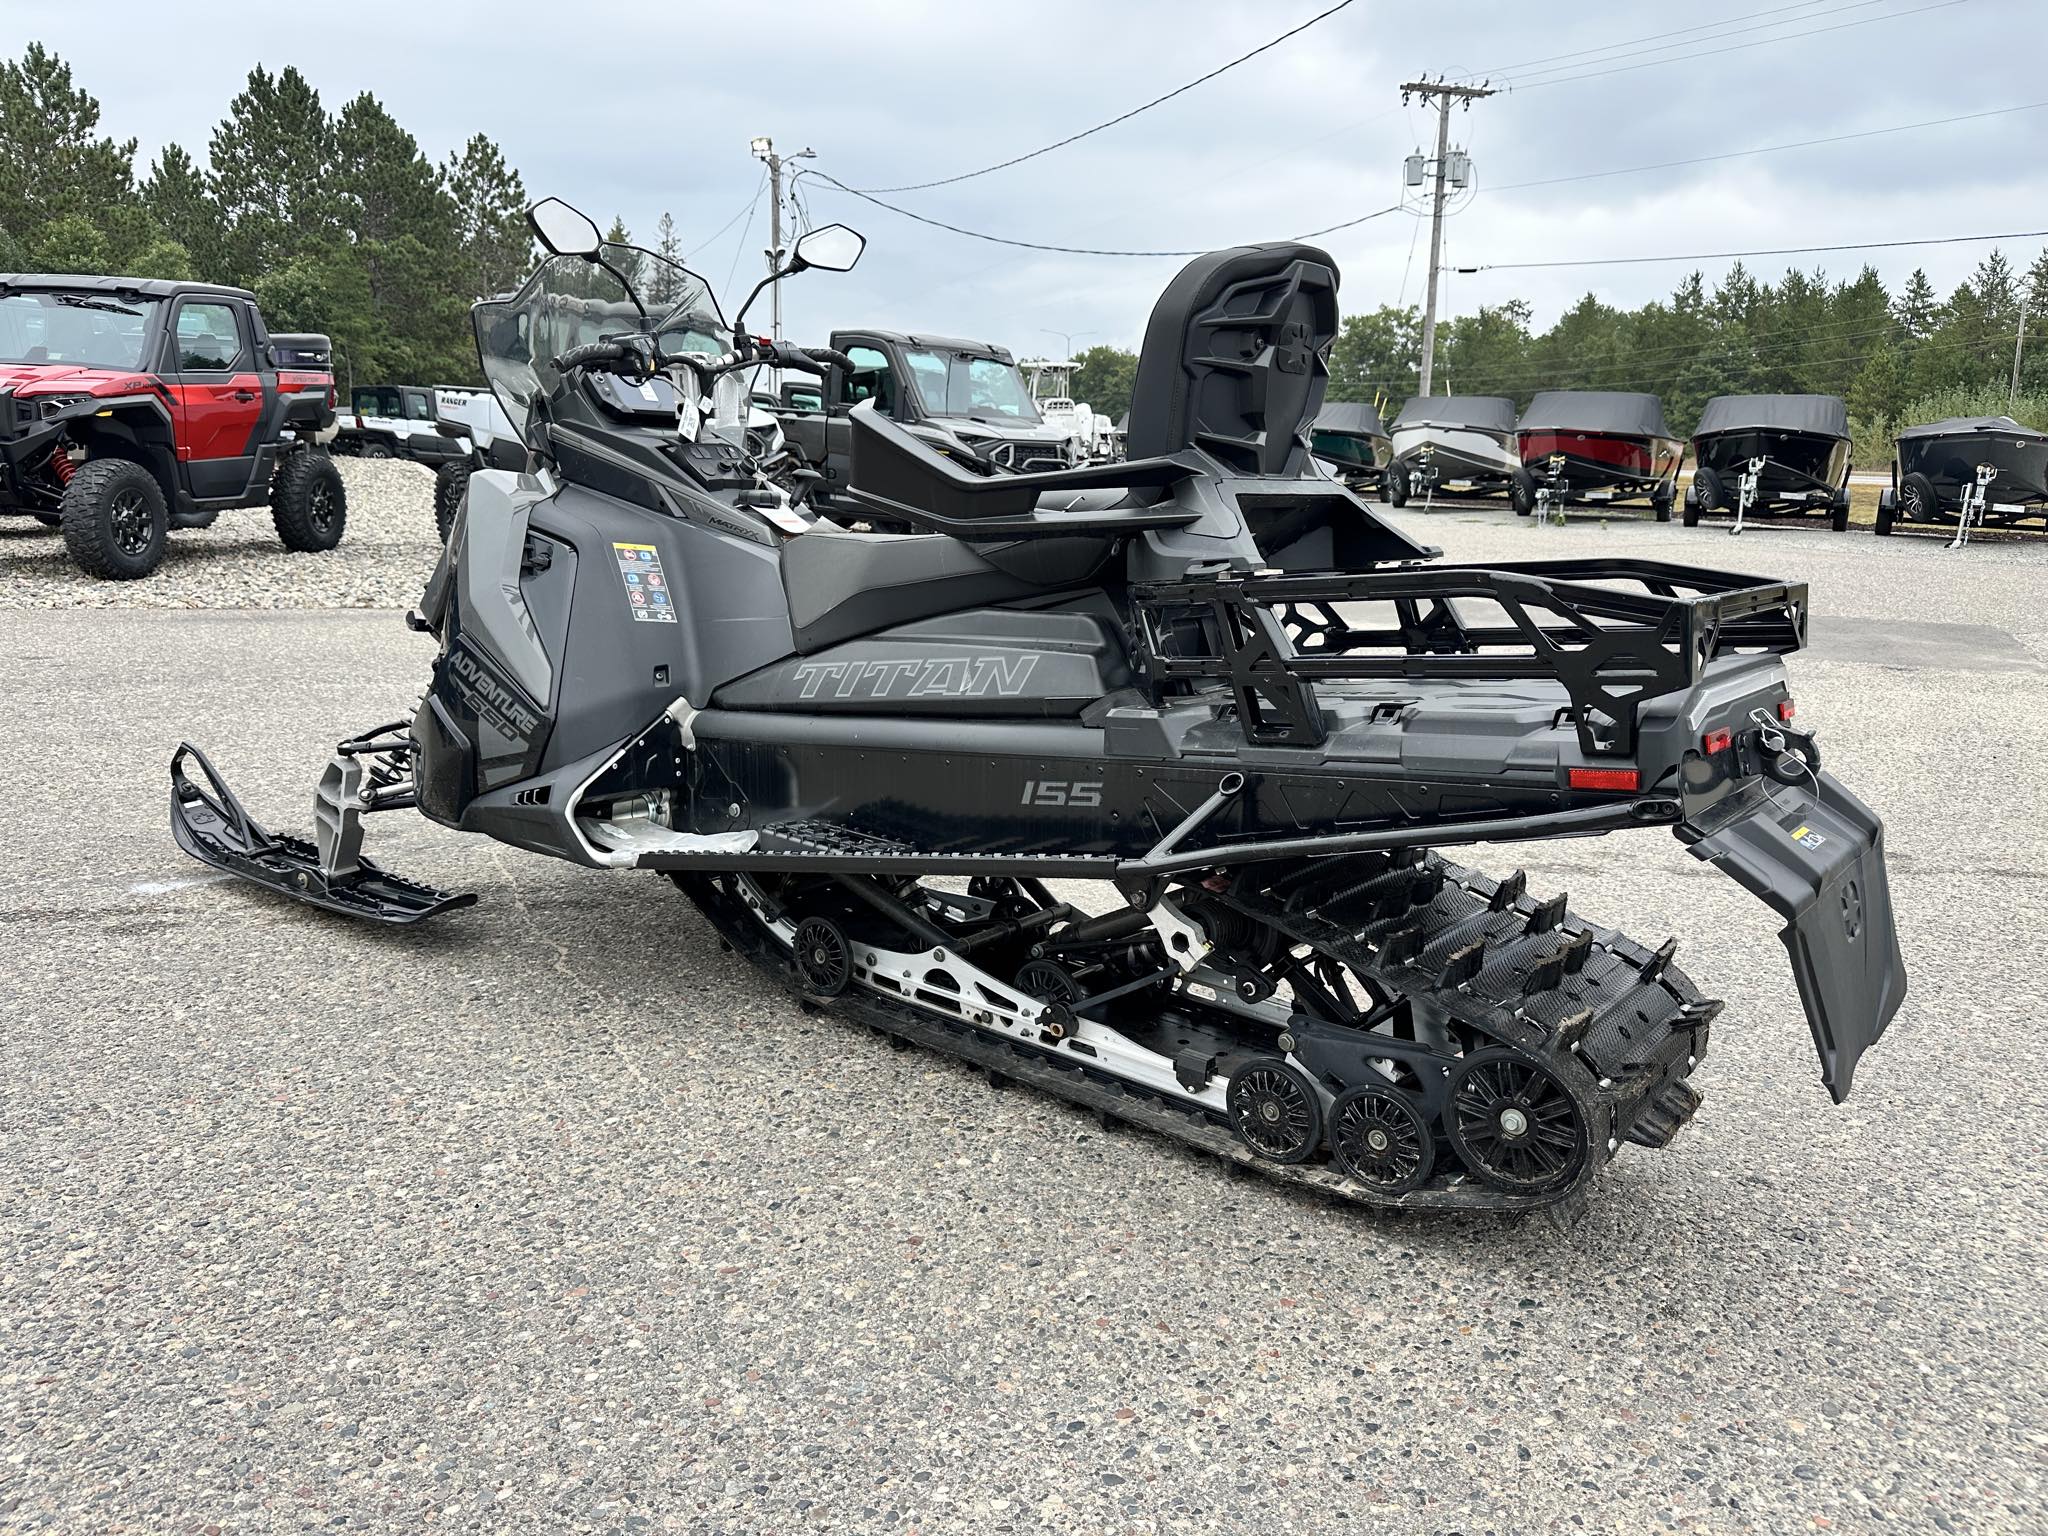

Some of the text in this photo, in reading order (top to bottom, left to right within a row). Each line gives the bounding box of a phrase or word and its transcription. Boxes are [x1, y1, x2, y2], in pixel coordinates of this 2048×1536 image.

[124, 381, 142, 391] XP
[441, 396, 468, 407] RANGER
[708, 516, 760, 541] MATRYX
[793, 655, 1040, 699] TITAN
[448, 650, 539, 735] ADVENTURE
[463, 690, 520, 742] 650
[1021, 781, 1104, 807] 155
